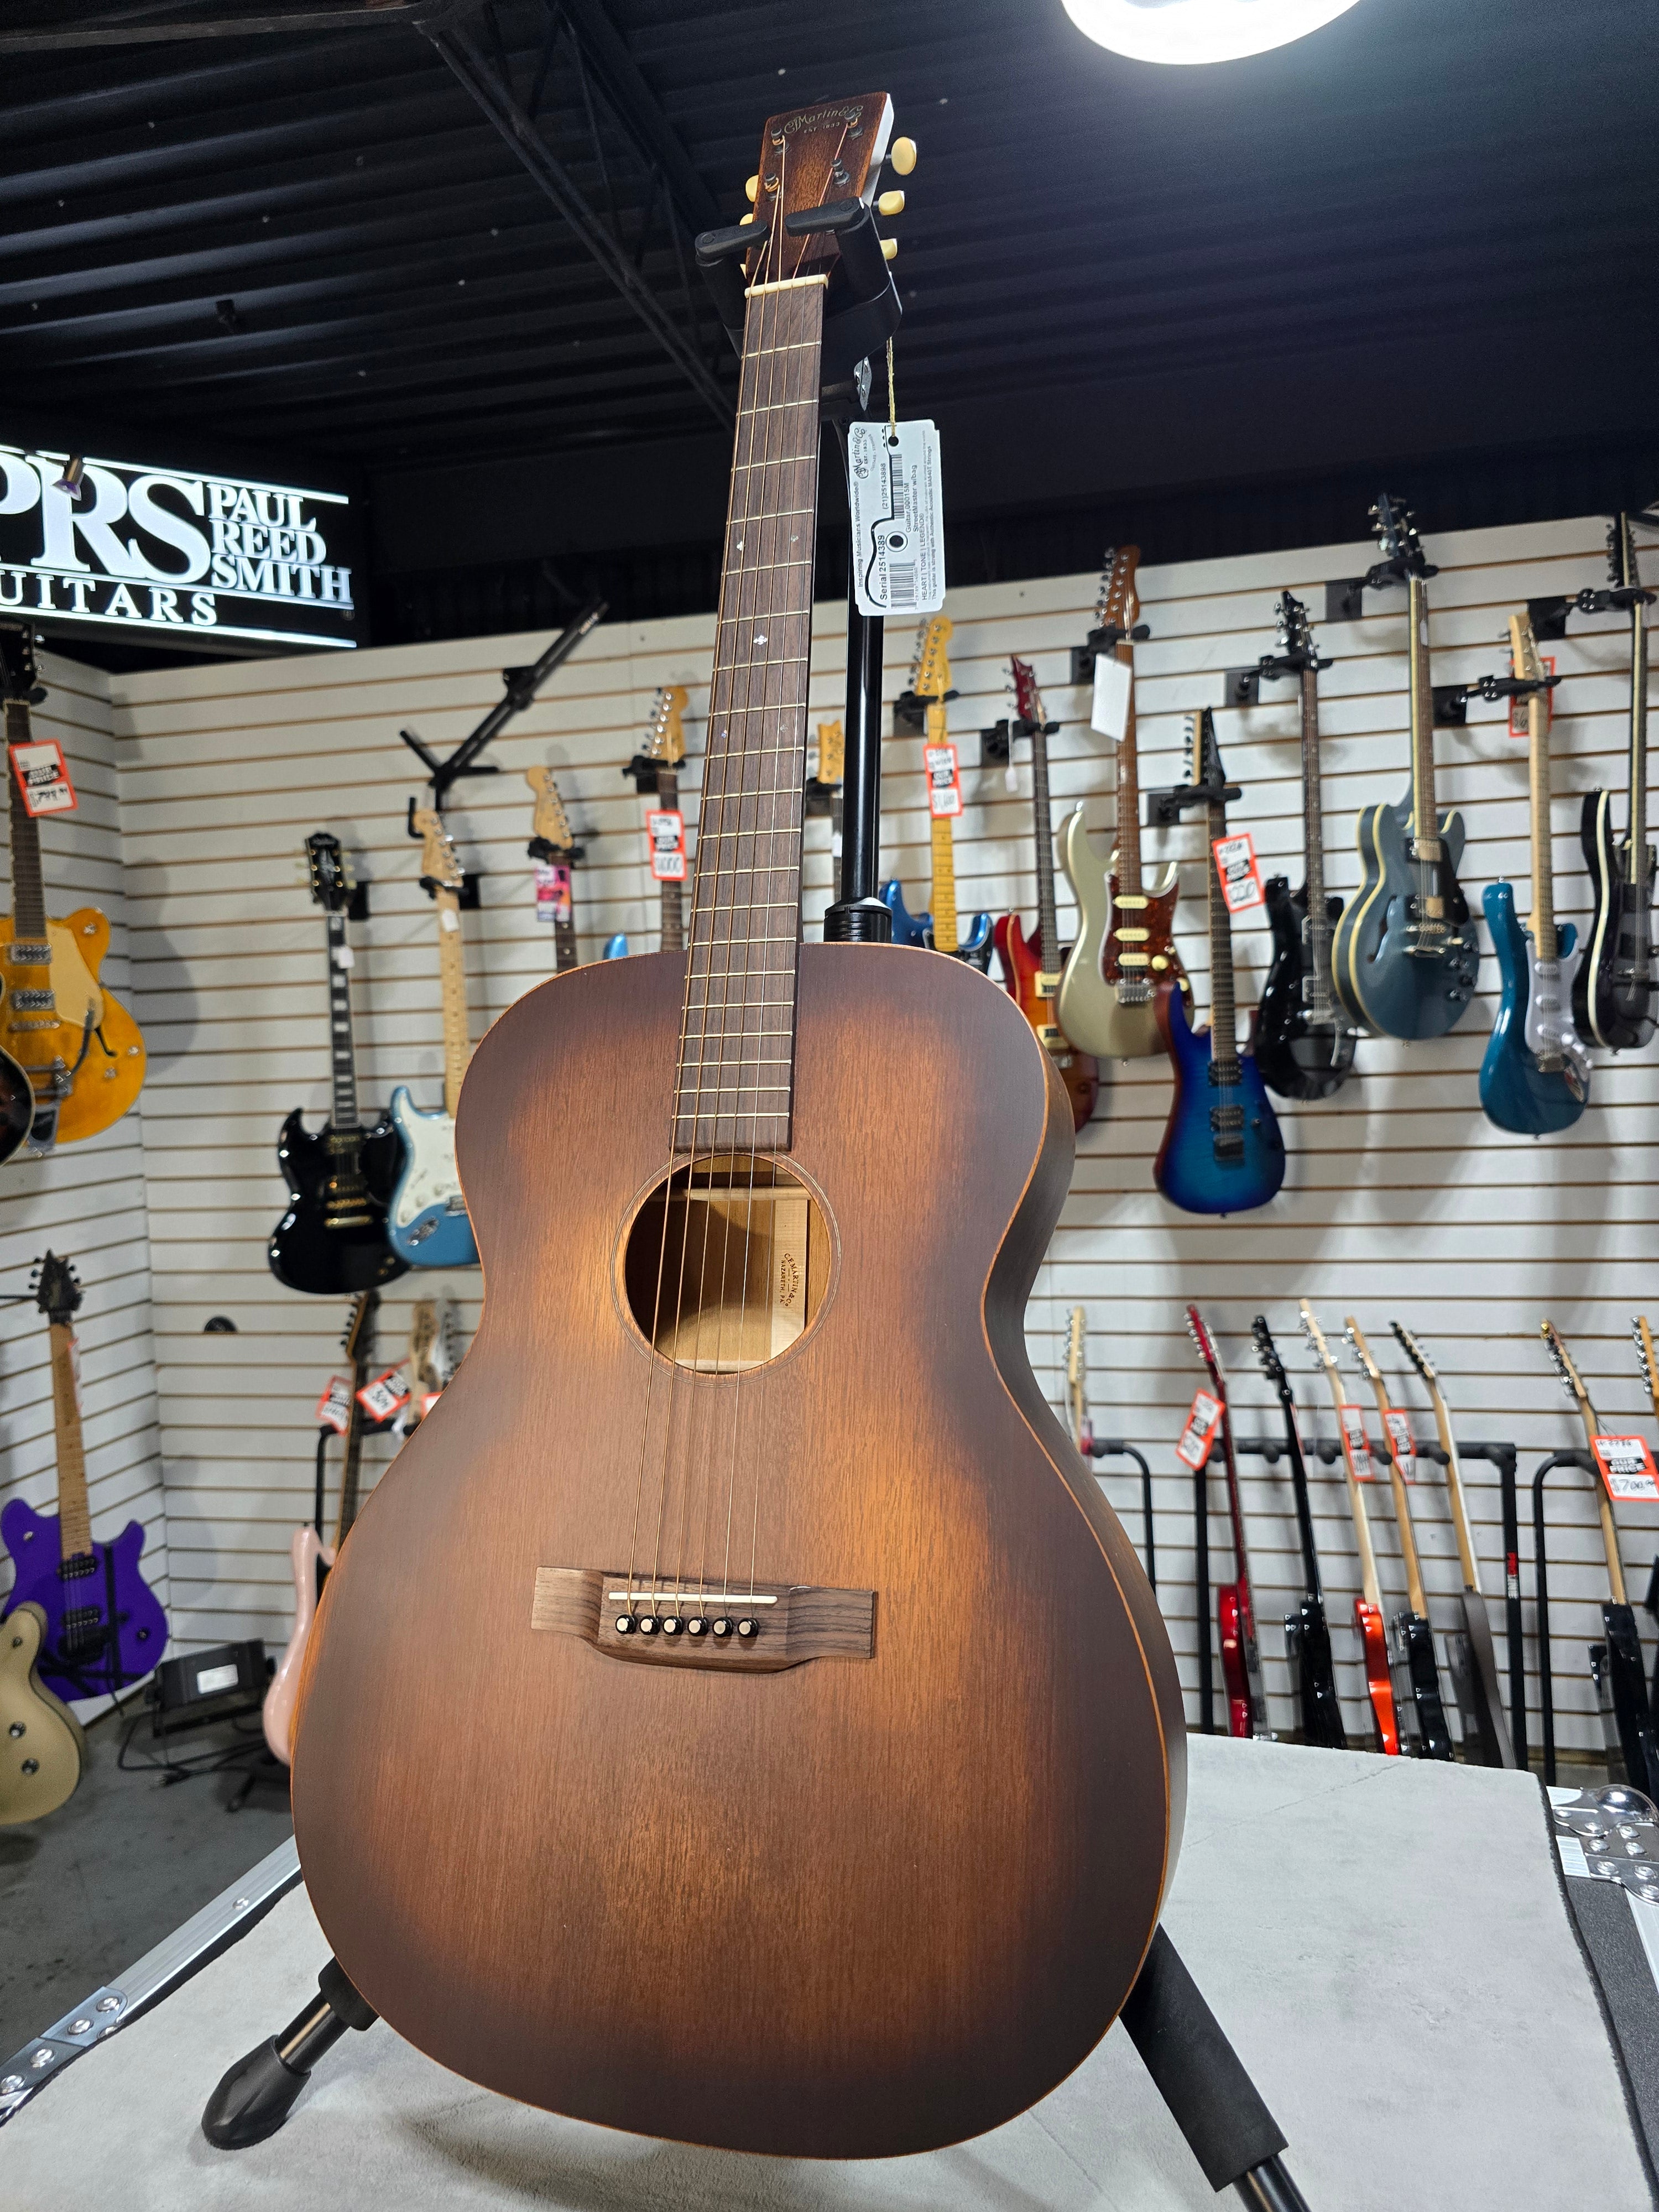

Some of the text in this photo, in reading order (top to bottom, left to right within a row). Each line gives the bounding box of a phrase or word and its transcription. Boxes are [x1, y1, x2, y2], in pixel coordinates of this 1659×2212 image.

[206, 482, 316, 533] PAUL
[880, 463, 889, 509] (21)25143898
[210, 518, 327, 565] REED
[878, 535, 886, 572] 2514389
[0, 570, 217, 626] UITARS
[211, 554, 352, 604] SMITH
[790, 1263, 799, 1293] MARTIN
[1609, 1463, 1646, 1473] PRICE
